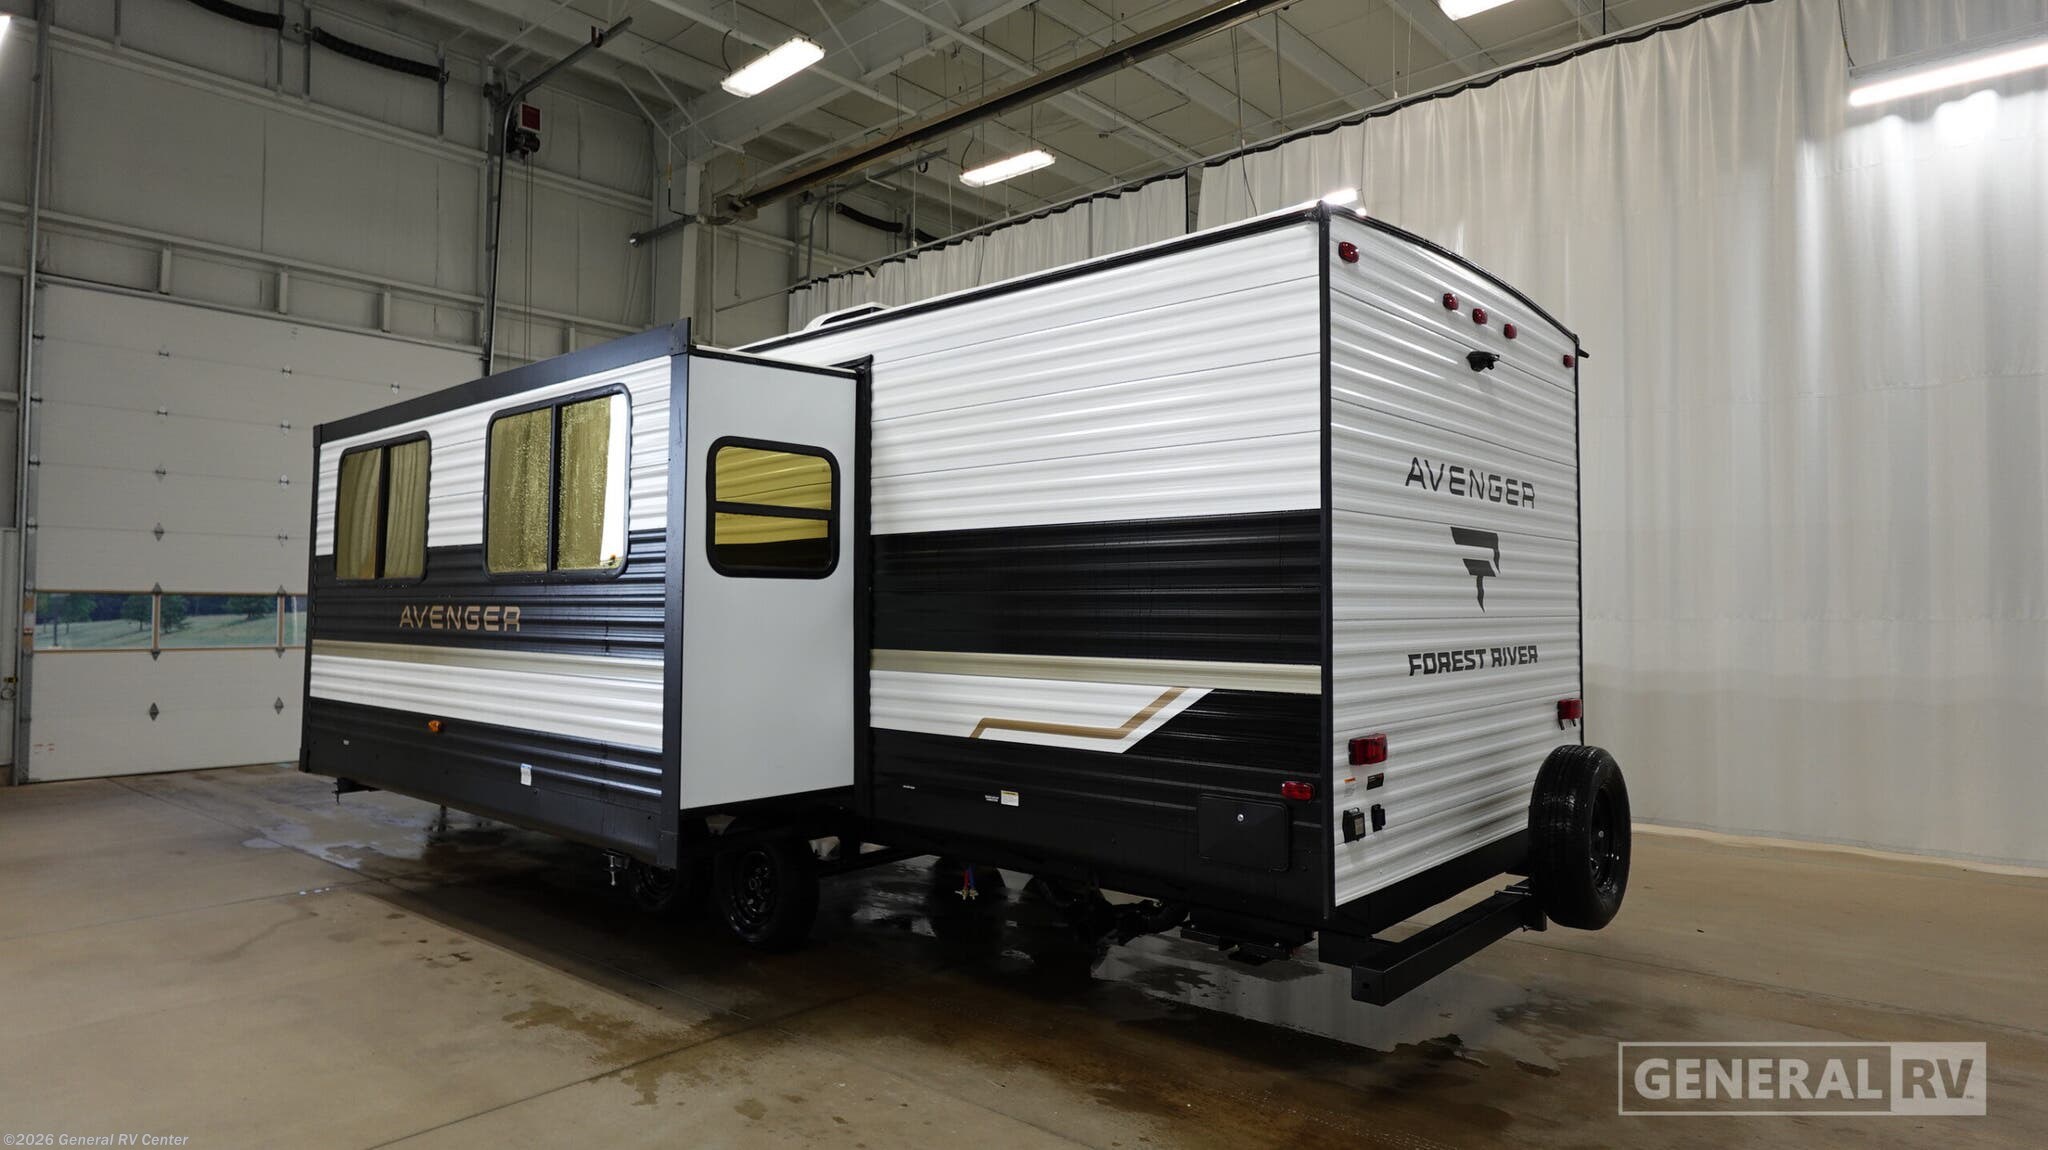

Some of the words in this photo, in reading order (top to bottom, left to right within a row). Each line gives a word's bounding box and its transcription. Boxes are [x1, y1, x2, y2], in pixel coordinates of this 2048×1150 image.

[1405, 457, 1535, 509] AVENGER
[400, 605, 520, 632] AVENGER
[1408, 648, 1486, 676] FOREST
[1490, 645, 1538, 668] RIVER
